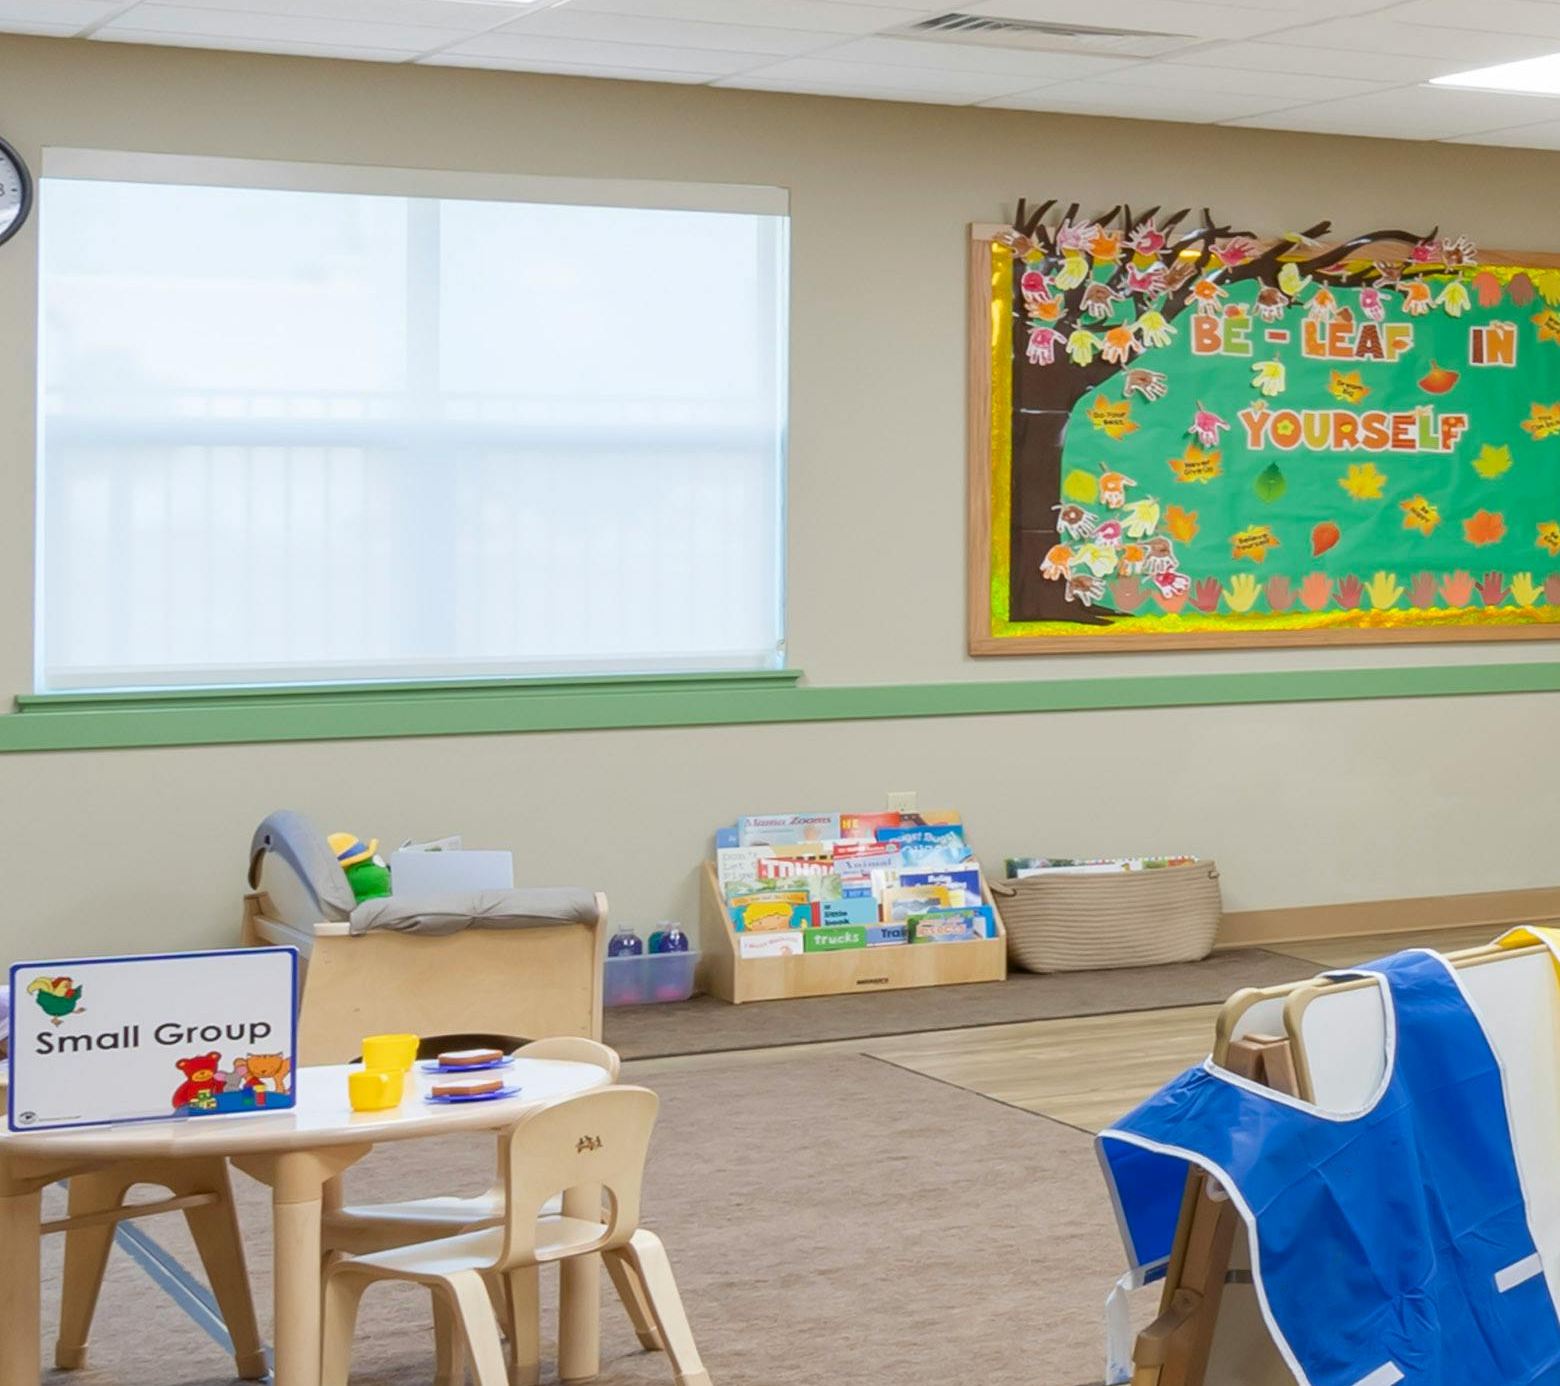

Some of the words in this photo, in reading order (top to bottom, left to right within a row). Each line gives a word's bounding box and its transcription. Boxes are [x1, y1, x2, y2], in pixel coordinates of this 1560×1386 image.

[1193, 315, 1251, 354] BE
[1304, 319, 1413, 360] LEAF
[1471, 326, 1516, 364] IN
[1240, 410, 1468, 451] YOURSELF
[814, 932, 860, 945] trucks
[36, 1025, 139, 1055] Small
[154, 1021, 271, 1046] Group
